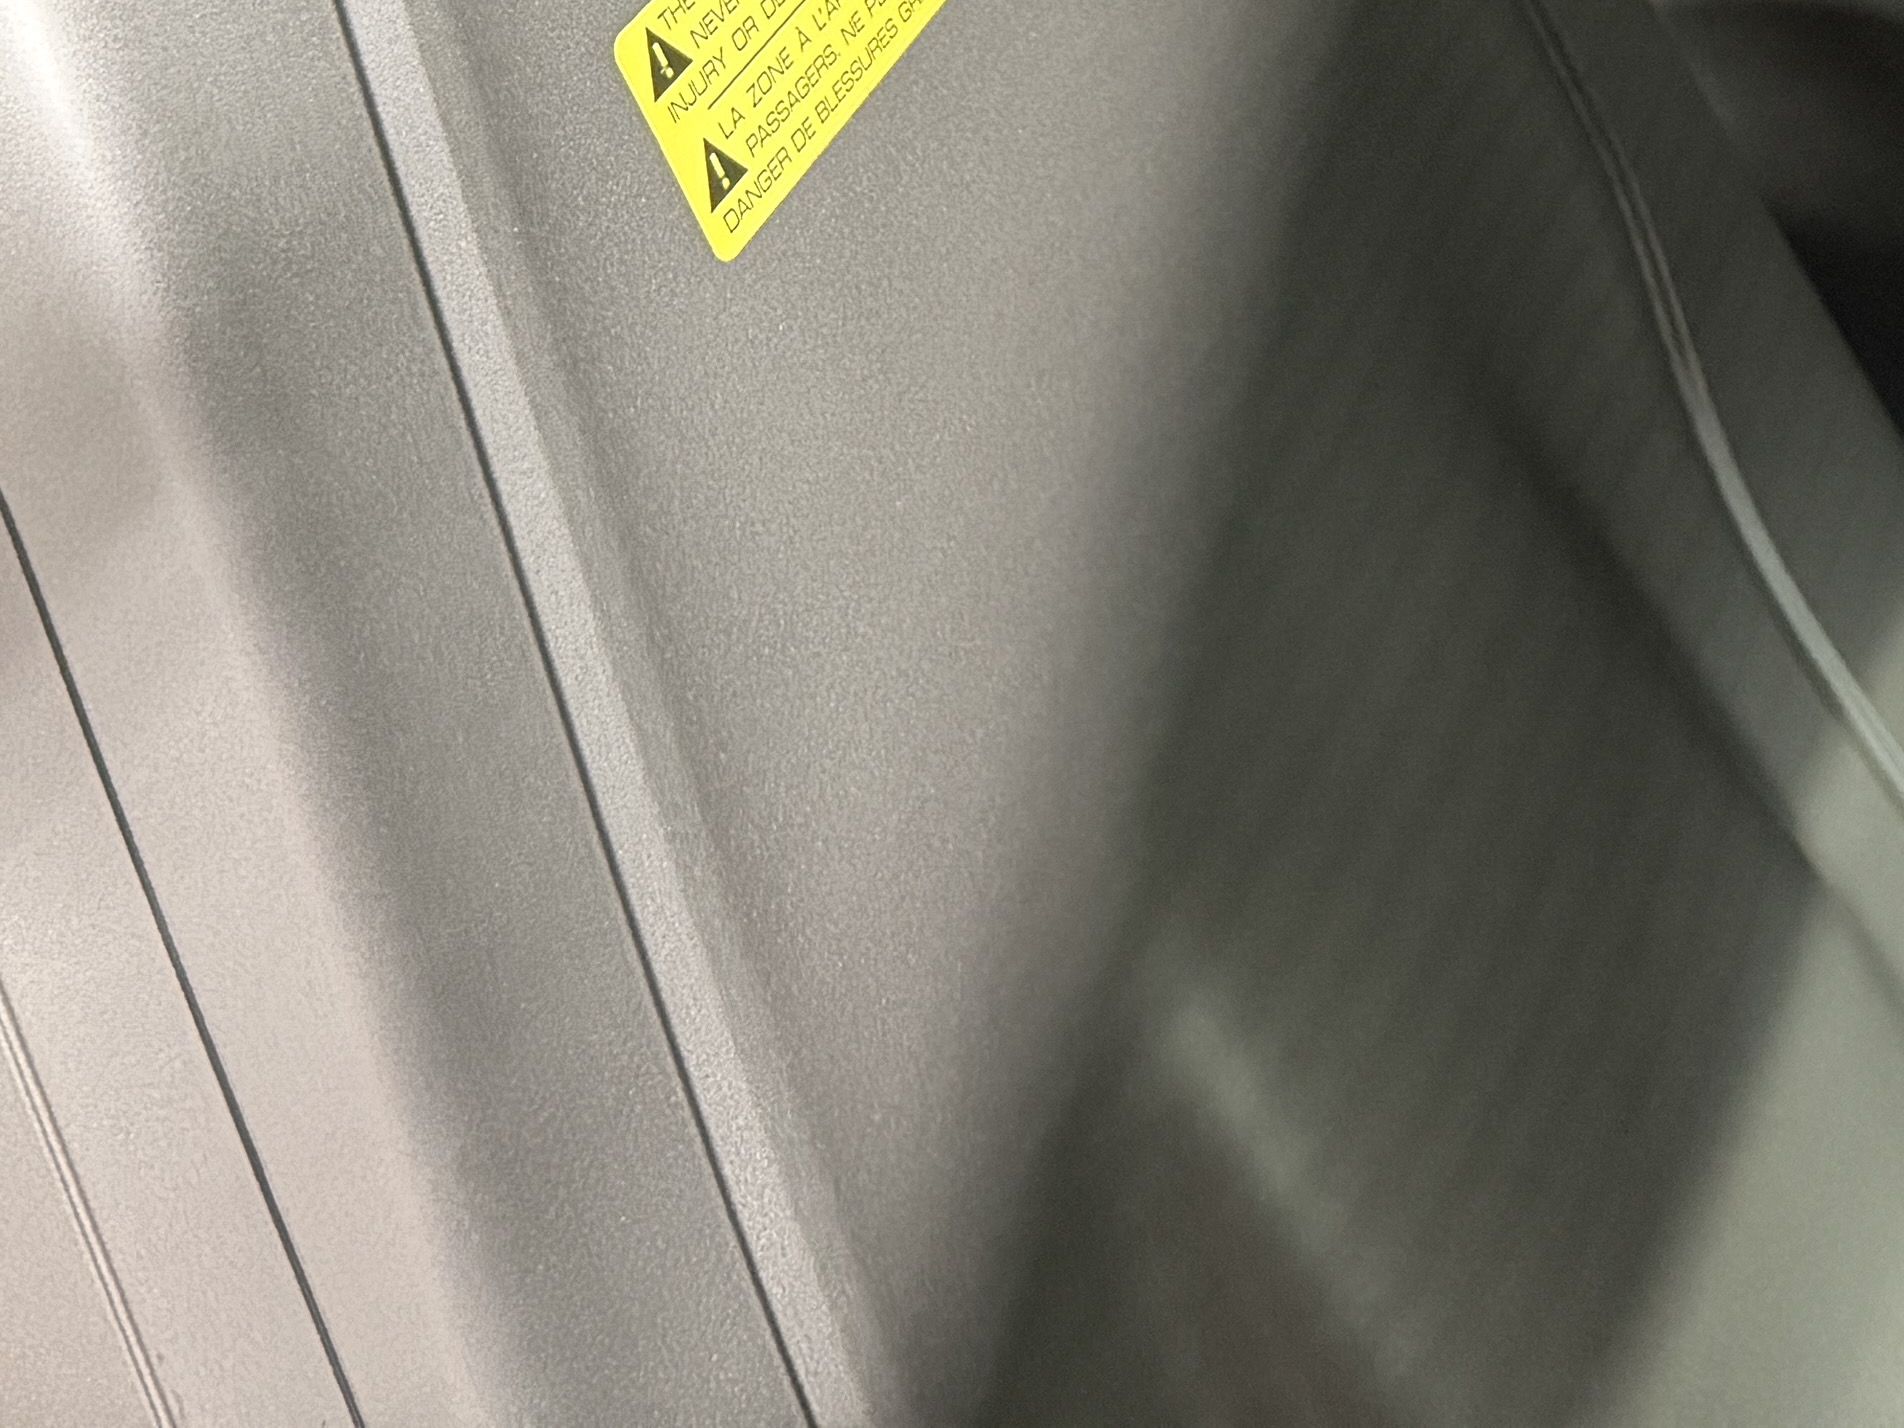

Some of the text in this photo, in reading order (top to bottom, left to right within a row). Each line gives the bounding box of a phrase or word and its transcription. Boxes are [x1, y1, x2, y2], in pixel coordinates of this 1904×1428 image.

[667, 46, 726, 123] INJURY
[731, 15, 759, 51] OR
[717, 106, 745, 139] LA
[745, 45, 794, 108] ZONE
[794, 26, 811, 52] À
[722, 145, 792, 233] DANGER
[790, 115, 816, 153] DE
[814, 17, 898, 124] BLESSURES
[745, 43, 840, 158] PASSAGERS.
[840, 9, 865, 45] NE
